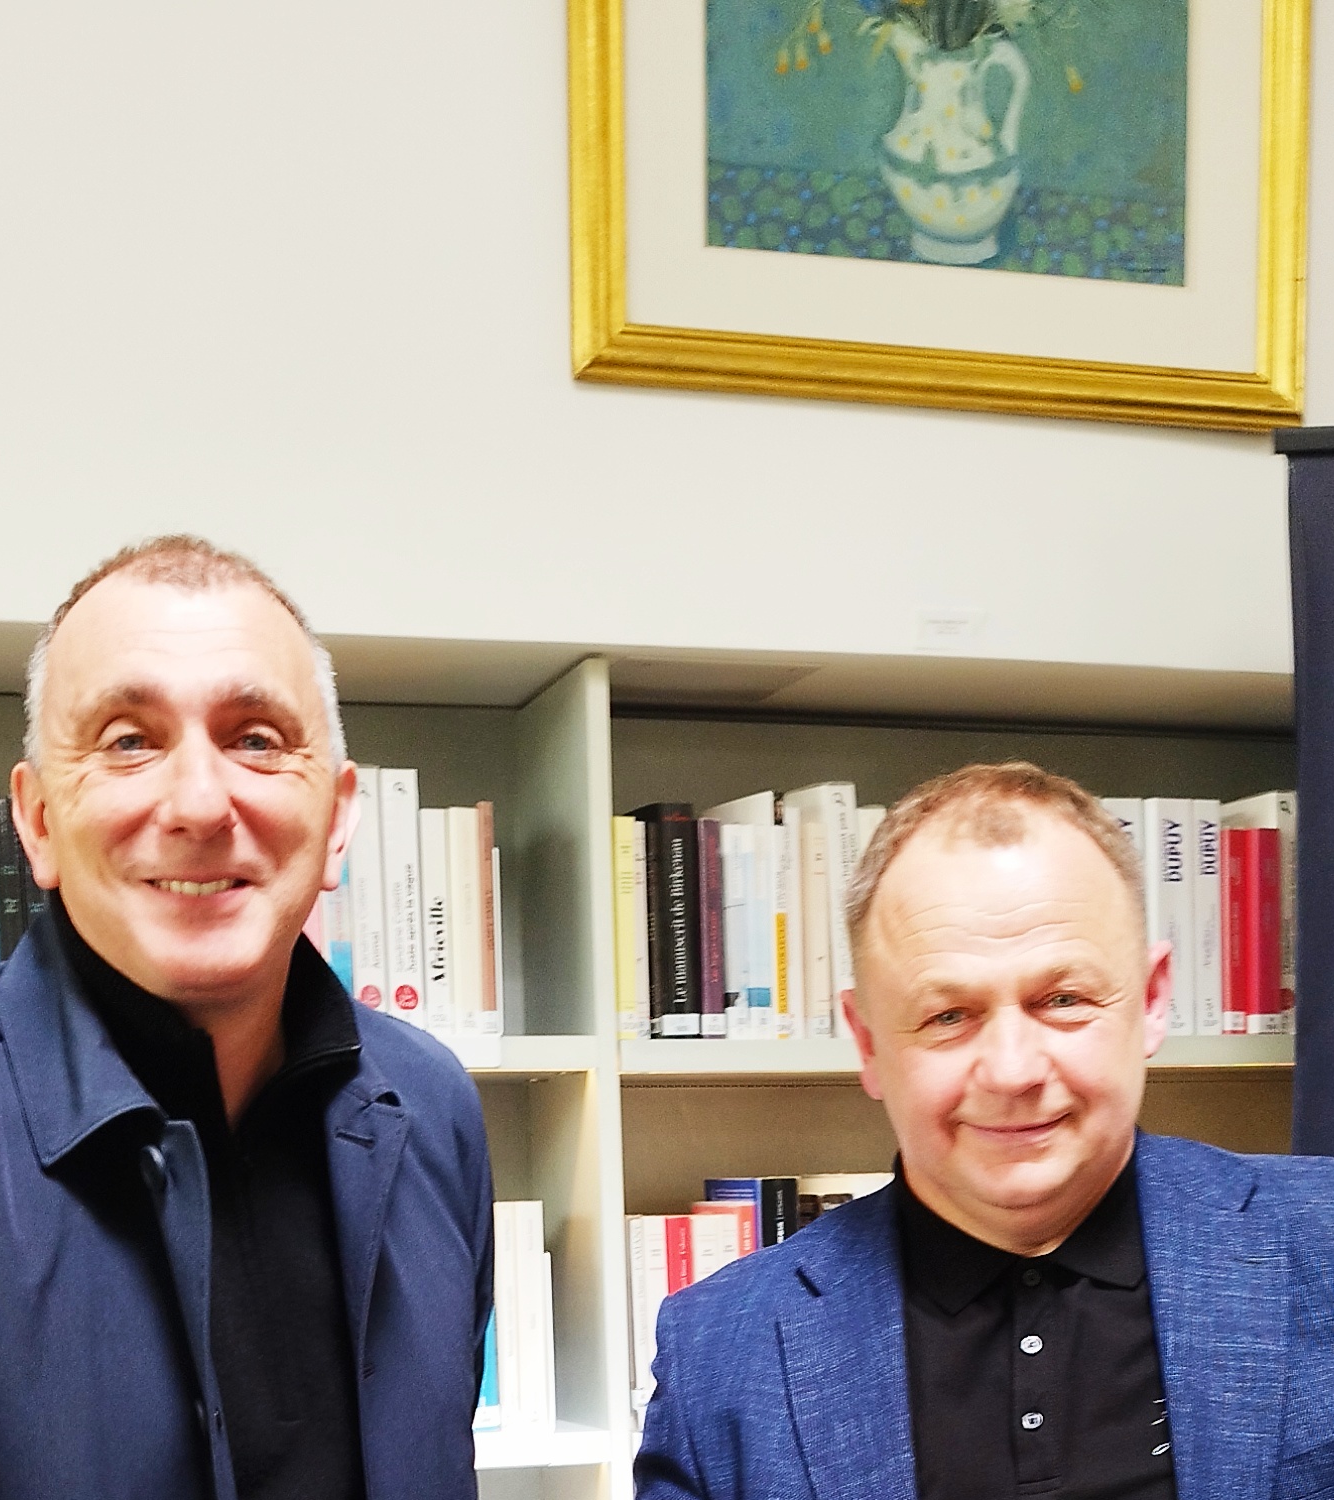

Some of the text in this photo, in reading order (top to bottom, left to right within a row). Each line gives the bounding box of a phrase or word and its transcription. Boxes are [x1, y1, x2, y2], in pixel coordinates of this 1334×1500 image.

[1167, 818, 1183, 881] DUPUY
[1202, 819, 1218, 873] DUPUY
[428, 896, 448, 983] Africville
[668, 839, 689, 1002] Le manuscrit de Birkenau
